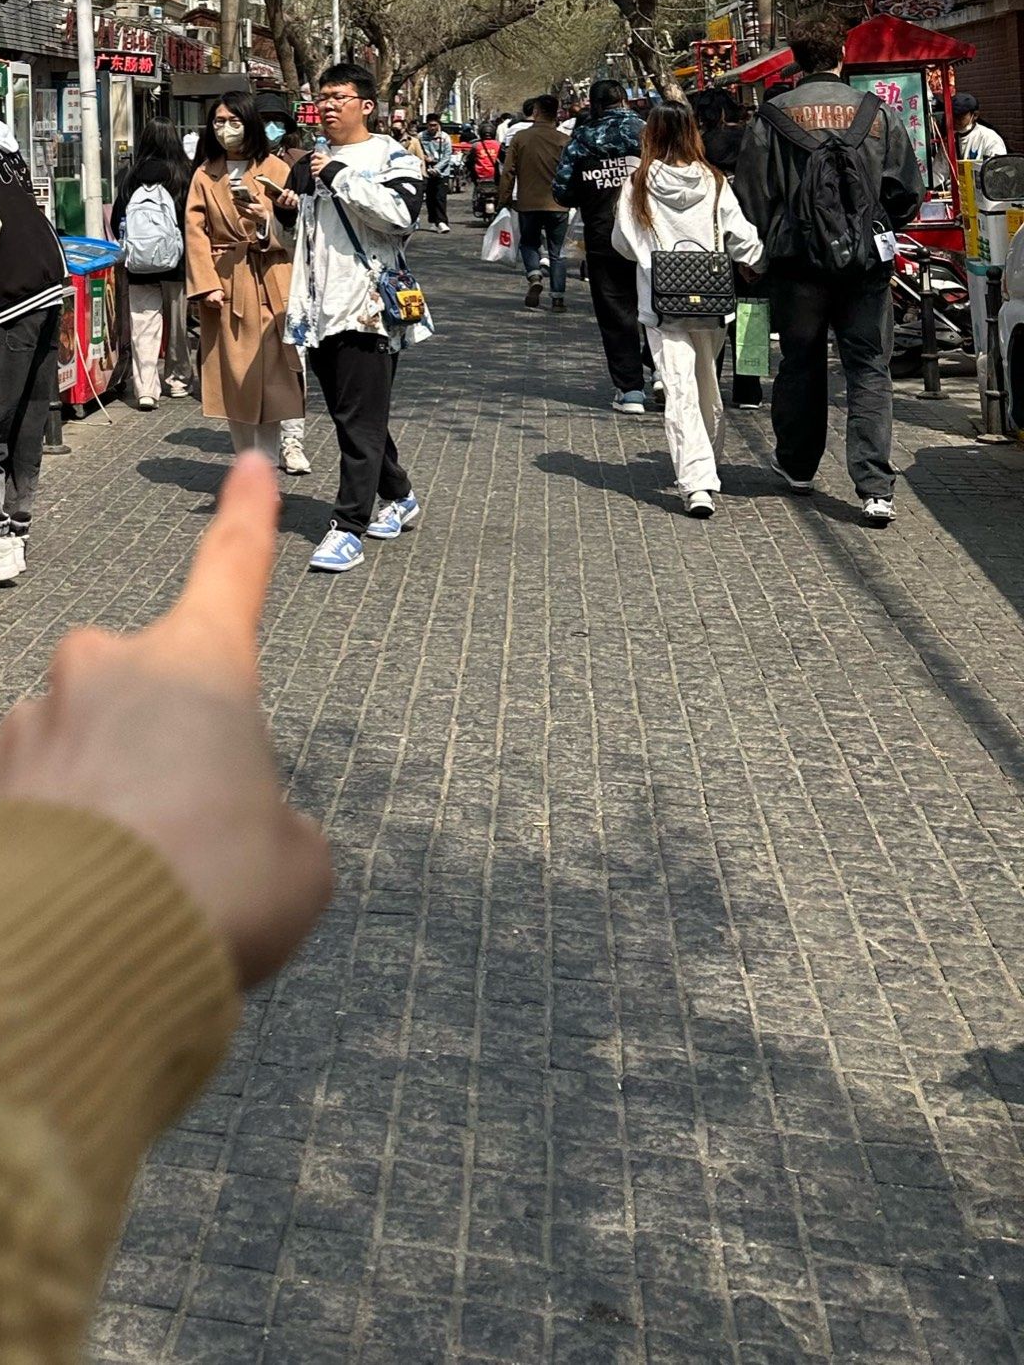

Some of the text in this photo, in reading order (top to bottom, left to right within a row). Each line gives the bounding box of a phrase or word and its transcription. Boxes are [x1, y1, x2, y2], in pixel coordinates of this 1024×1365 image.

[95, 53, 154, 74] 广东肠粉
[600, 157, 626, 168] THE
[582, 167, 627, 181] NORTH
